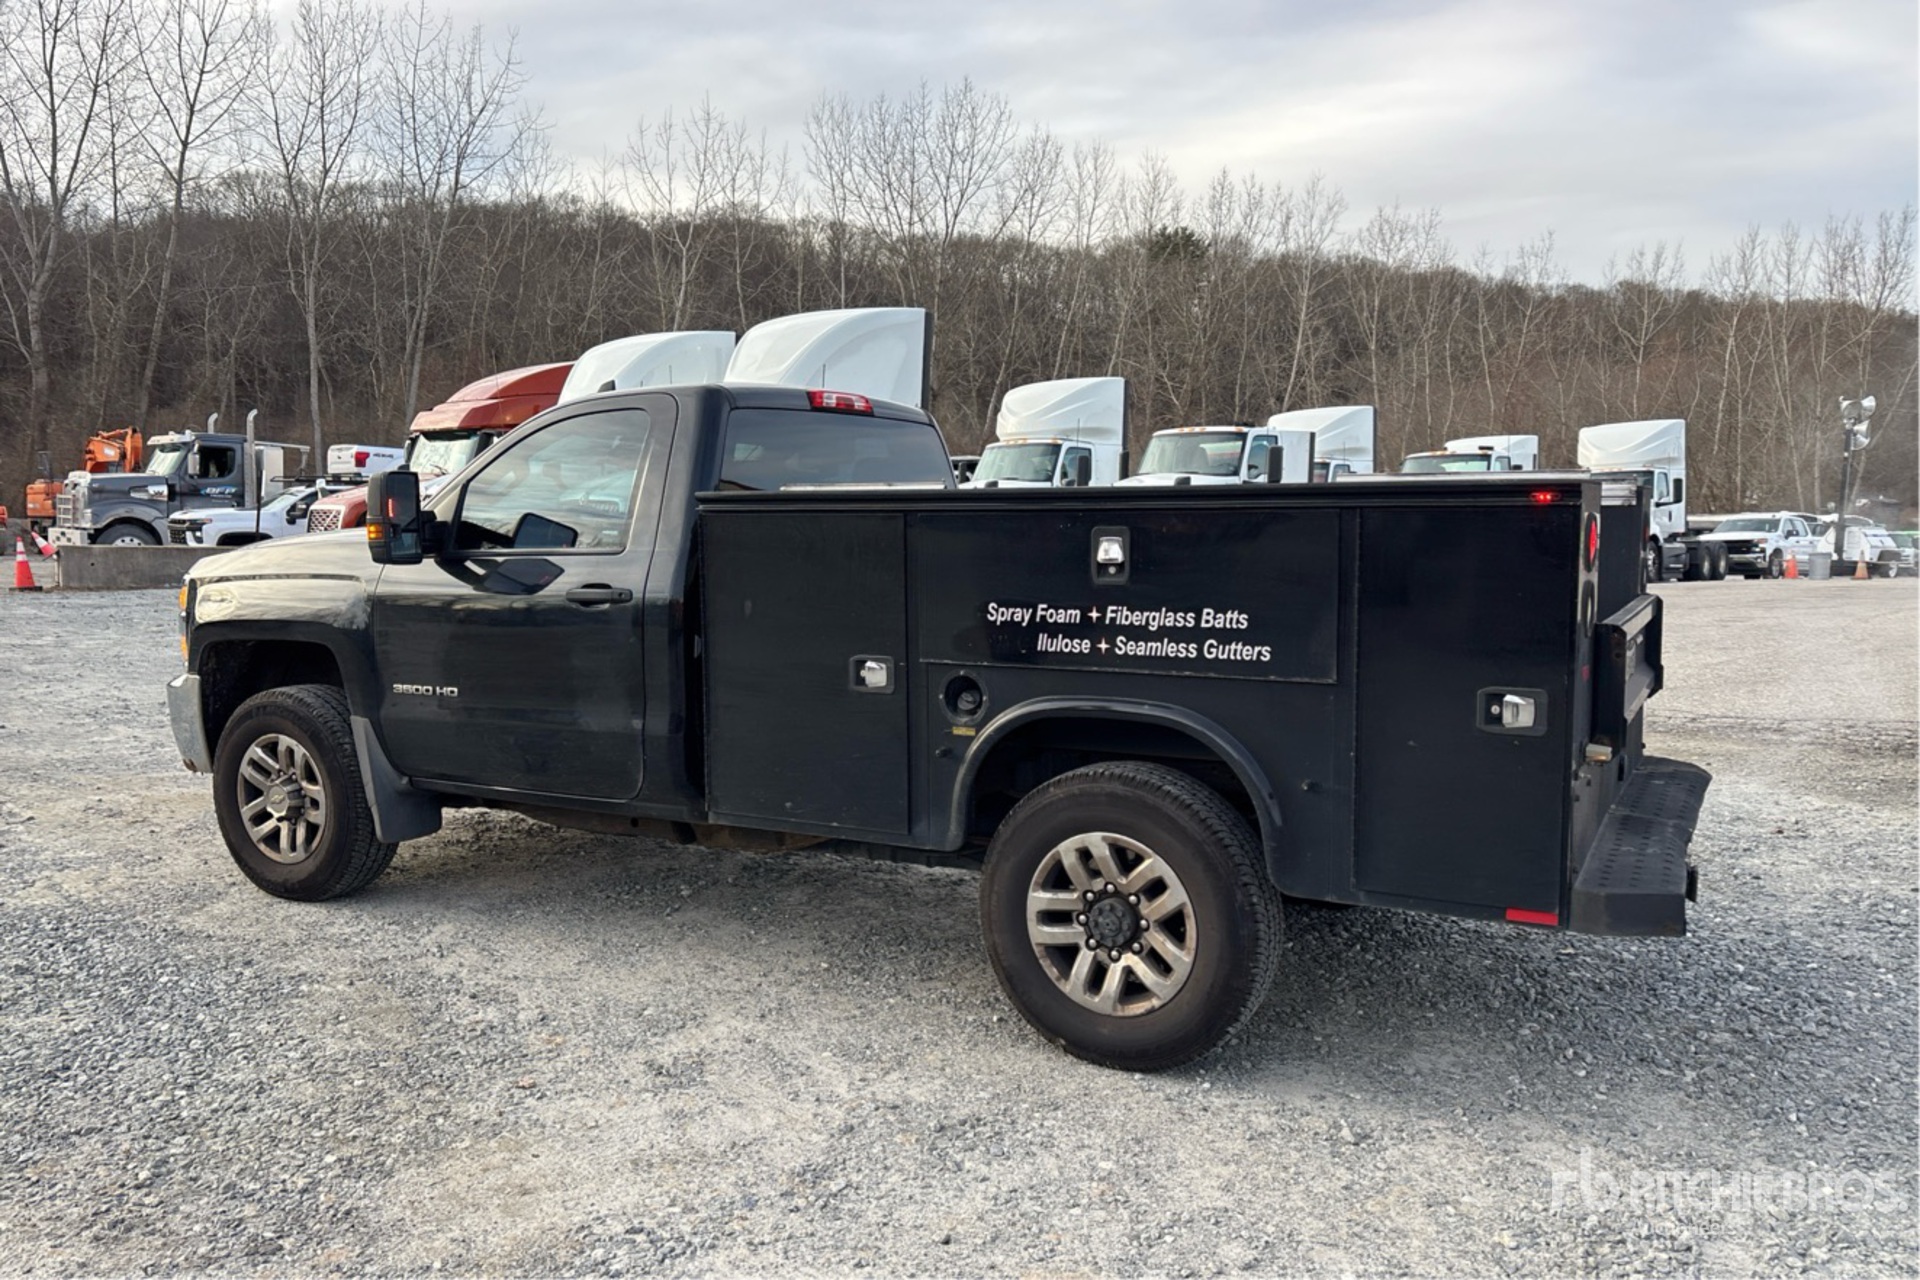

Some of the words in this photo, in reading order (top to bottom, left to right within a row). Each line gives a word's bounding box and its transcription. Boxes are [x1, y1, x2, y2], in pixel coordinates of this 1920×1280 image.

[987, 602, 1032, 626] Spray
[1036, 604, 1081, 624] Foam
[1105, 605, 1196, 631] Fiberglass
[1200, 608, 1249, 629] Batts
[1115, 636, 1198, 658] Seamless
[1203, 639, 1272, 661] Gutters
[392, 684, 433, 696] 3500
[436, 686, 458, 697] HD
